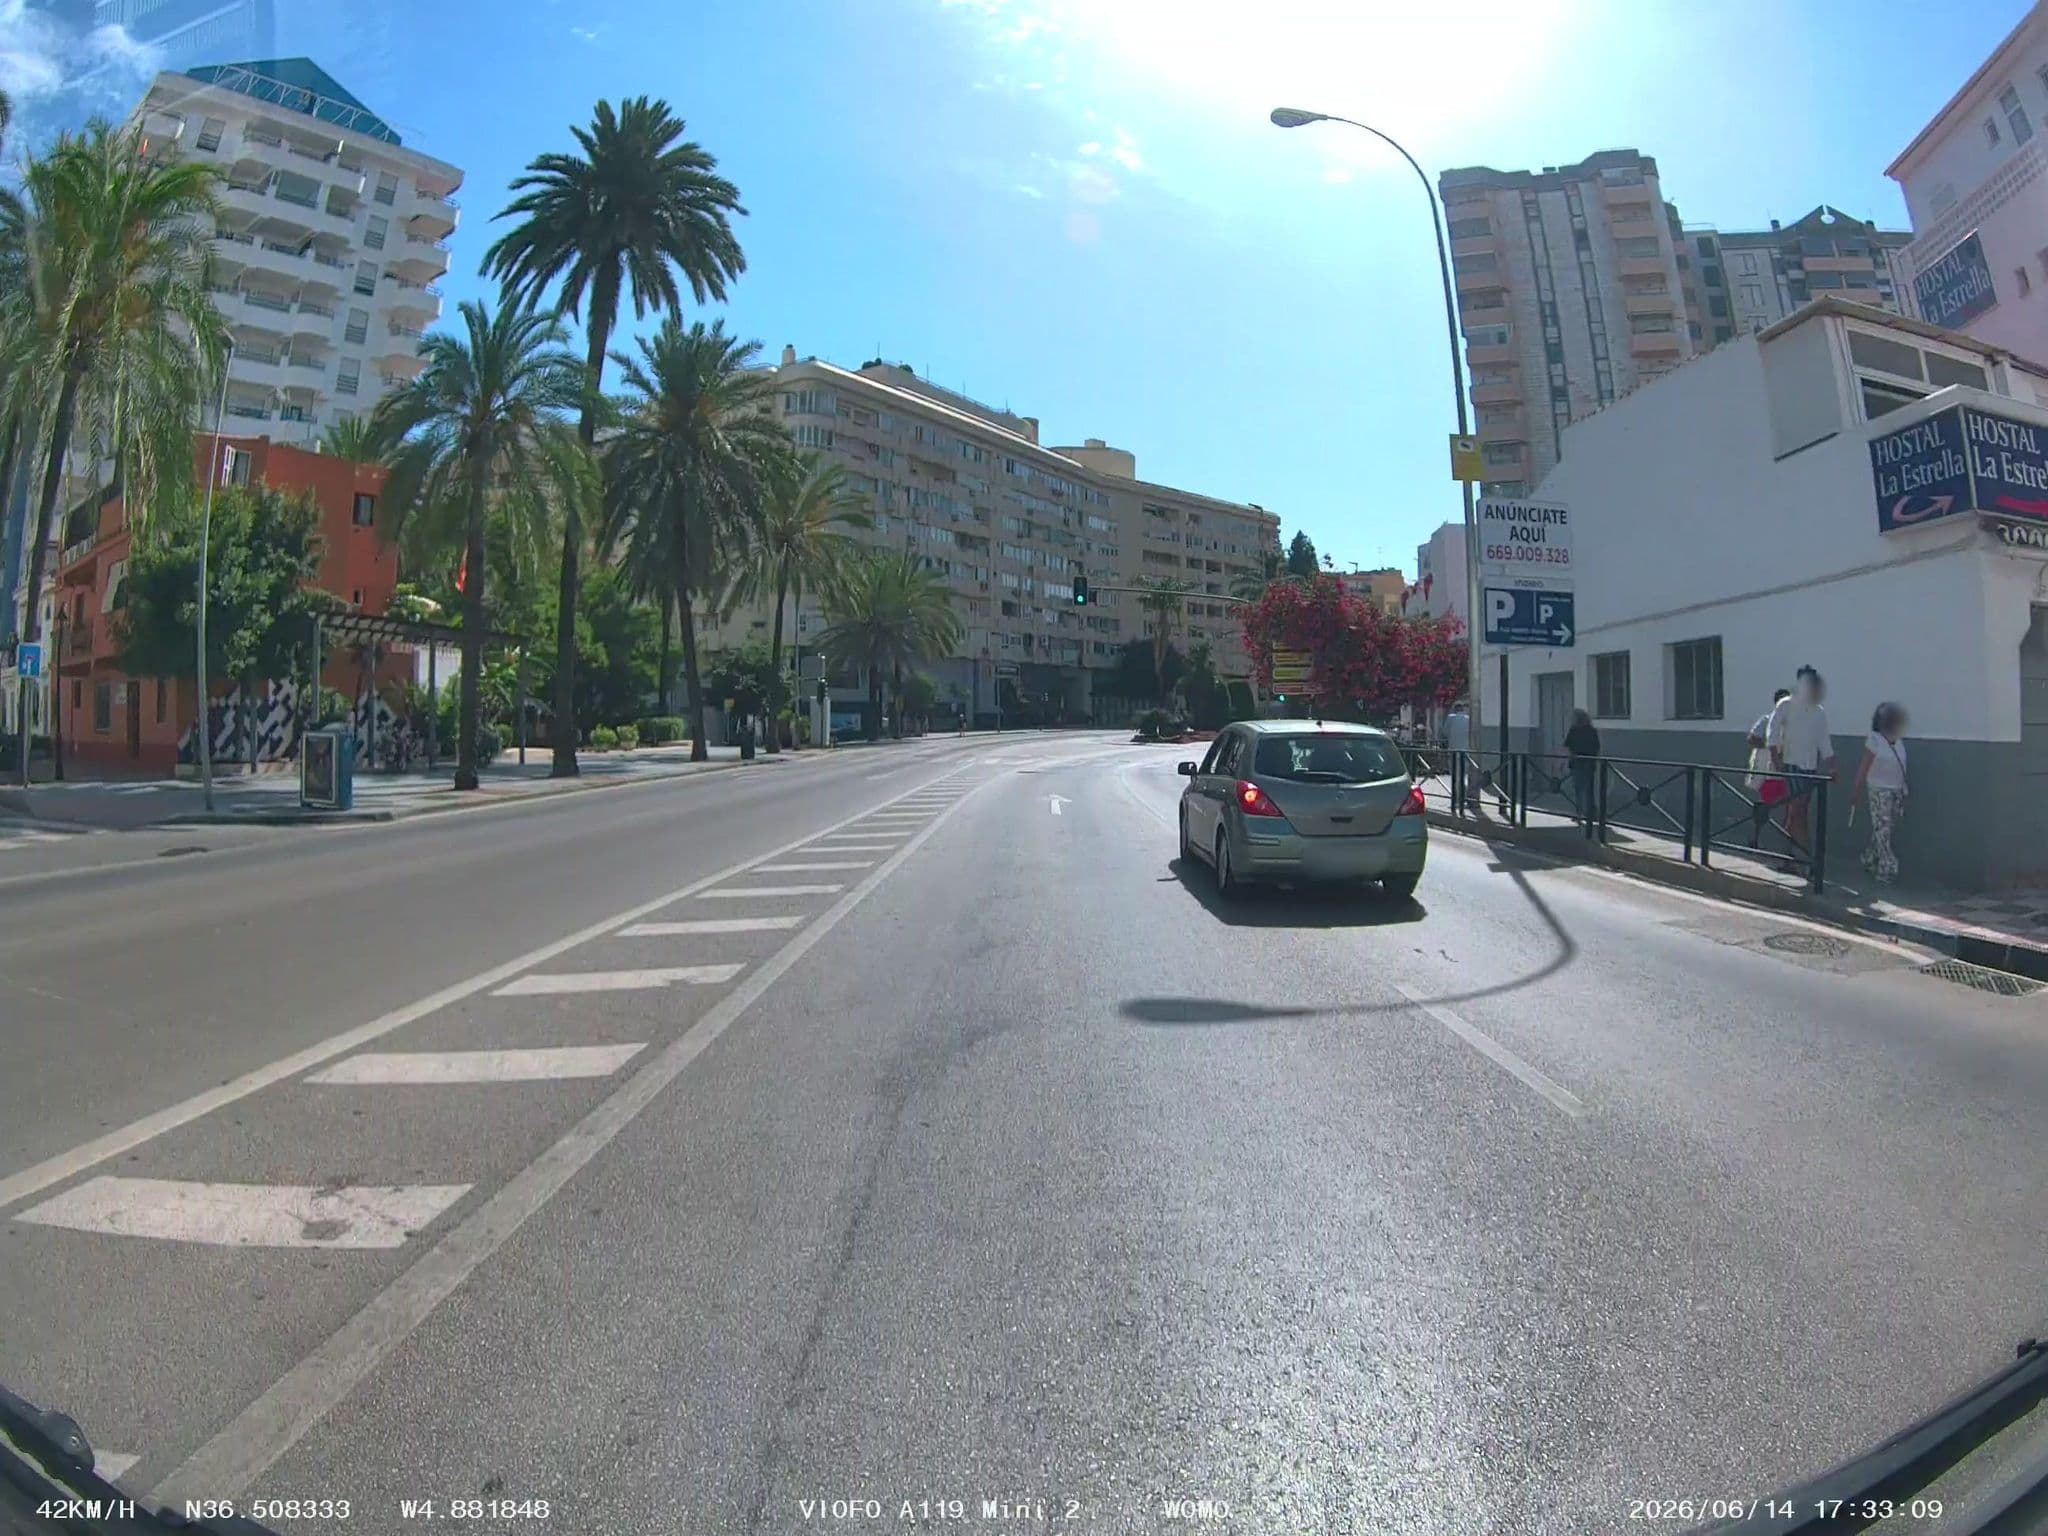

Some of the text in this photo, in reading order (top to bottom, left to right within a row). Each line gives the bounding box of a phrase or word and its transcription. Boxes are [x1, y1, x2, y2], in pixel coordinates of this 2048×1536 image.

[1915, 250, 1966, 299] HOSTAL
[1921, 265, 1992, 324] La Estrella
[1875, 420, 1946, 466] HOSTAL
[1968, 413, 2041, 455] HOSTAL
[1879, 449, 1966, 498] La Estrella
[1973, 446, 1998, 480] La
[1484, 502, 1568, 525] ANÚNCIATE
[1509, 525, 1546, 544] AQUÍ
[1487, 545, 1569, 564] 669.009.328
[1485, 589, 1516, 633] P
